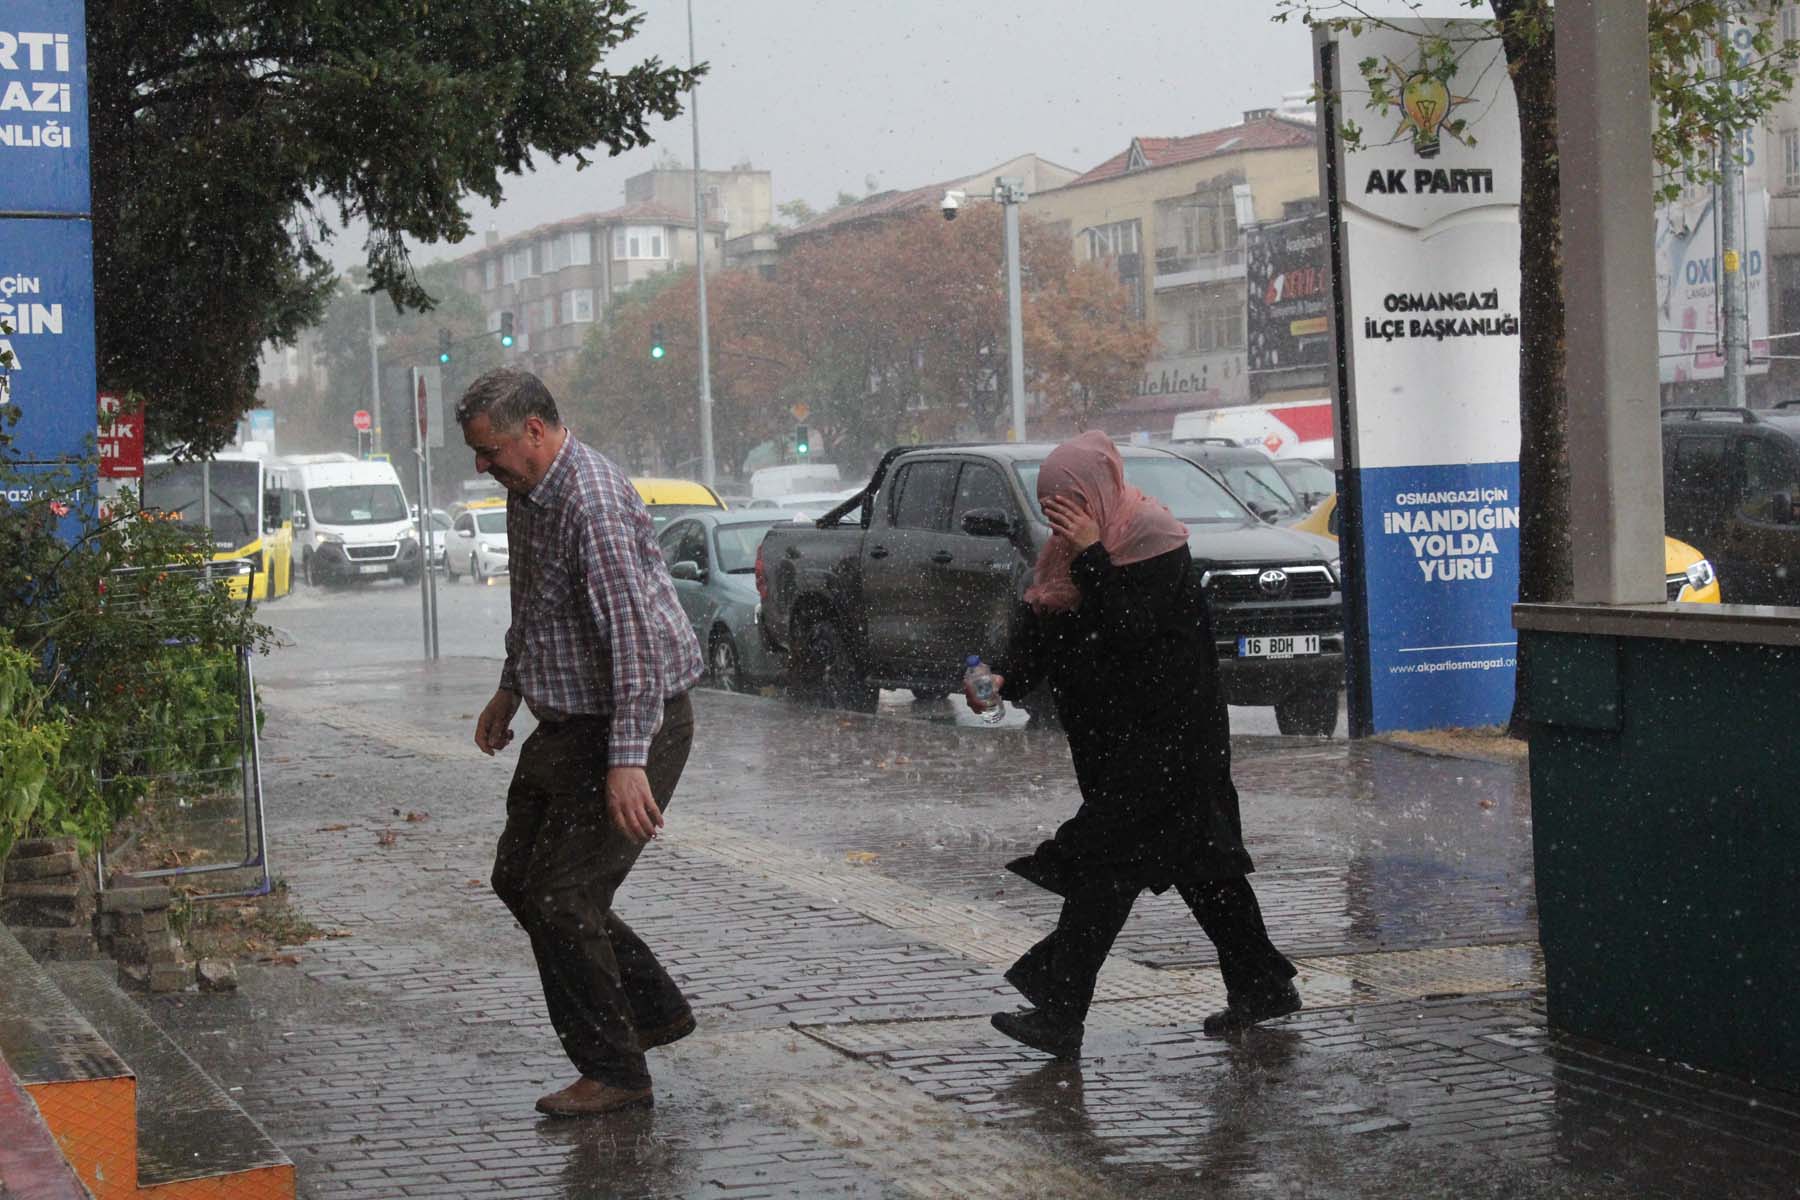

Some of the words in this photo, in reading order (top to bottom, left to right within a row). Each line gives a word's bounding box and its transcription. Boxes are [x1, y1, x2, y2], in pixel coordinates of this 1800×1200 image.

[1365, 168, 1408, 194] AK
[1414, 168, 1493, 194] PARTİ
[1384, 288, 1499, 312] OSMANGAZİ
[1365, 316, 1405, 342] İLÇE
[1409, 313, 1519, 342] BAŞKANLIĞI
[1396, 488, 1479, 506] OSMANGAZİ
[1481, 487, 1508, 504] İÇİN
[1384, 505, 1520, 535] İNANDIĞIN
[1408, 533, 1499, 558] YOLDA
[1418, 556, 1493, 582] YÜRÜ
[1247, 638, 1261, 655] 16
[1269, 637, 1294, 654] BDH
[1304, 636, 1318, 652] 11
[1389, 656, 1517, 674] www.akpartiosmangazi.or
